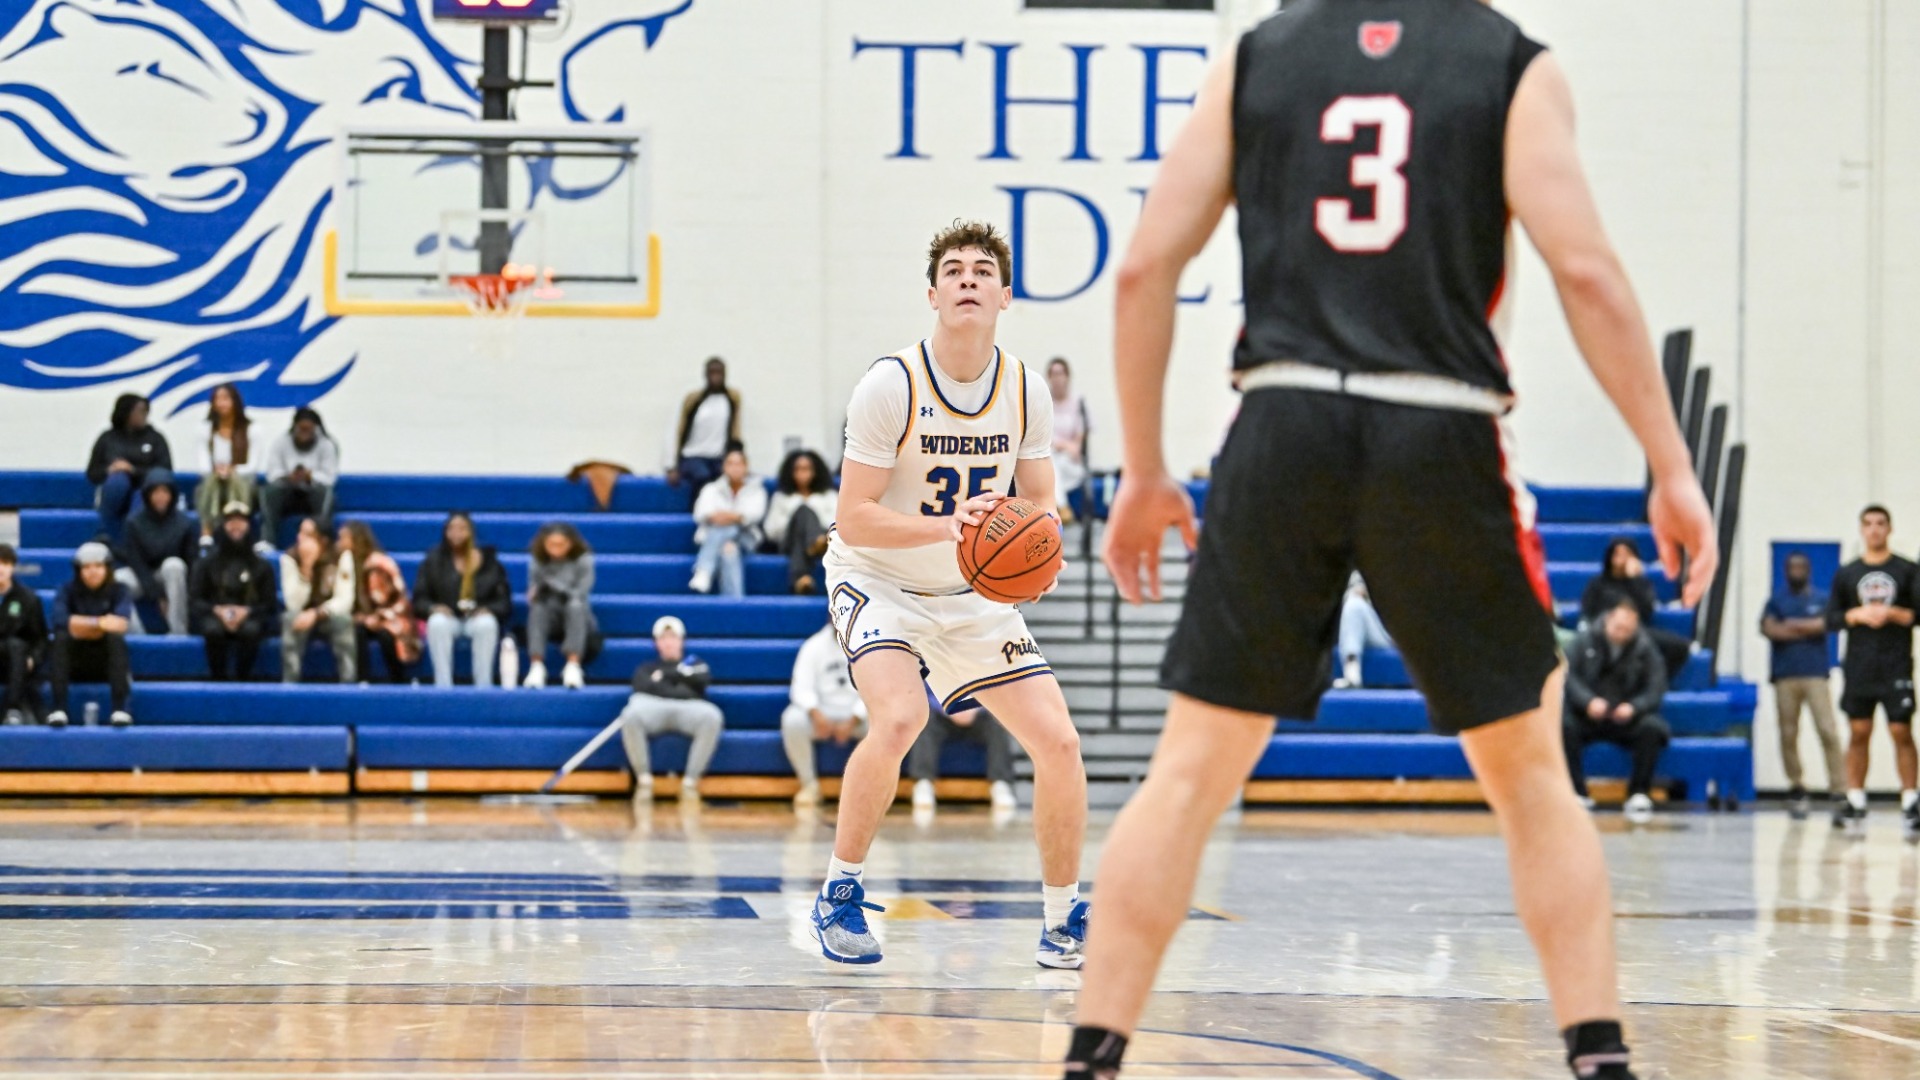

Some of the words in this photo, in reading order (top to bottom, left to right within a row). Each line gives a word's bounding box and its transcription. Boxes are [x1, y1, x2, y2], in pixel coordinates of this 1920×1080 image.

[1314, 95, 1412, 253] 3
[920, 434, 1009, 455] WIDENER
[984, 512, 1017, 543] THE
